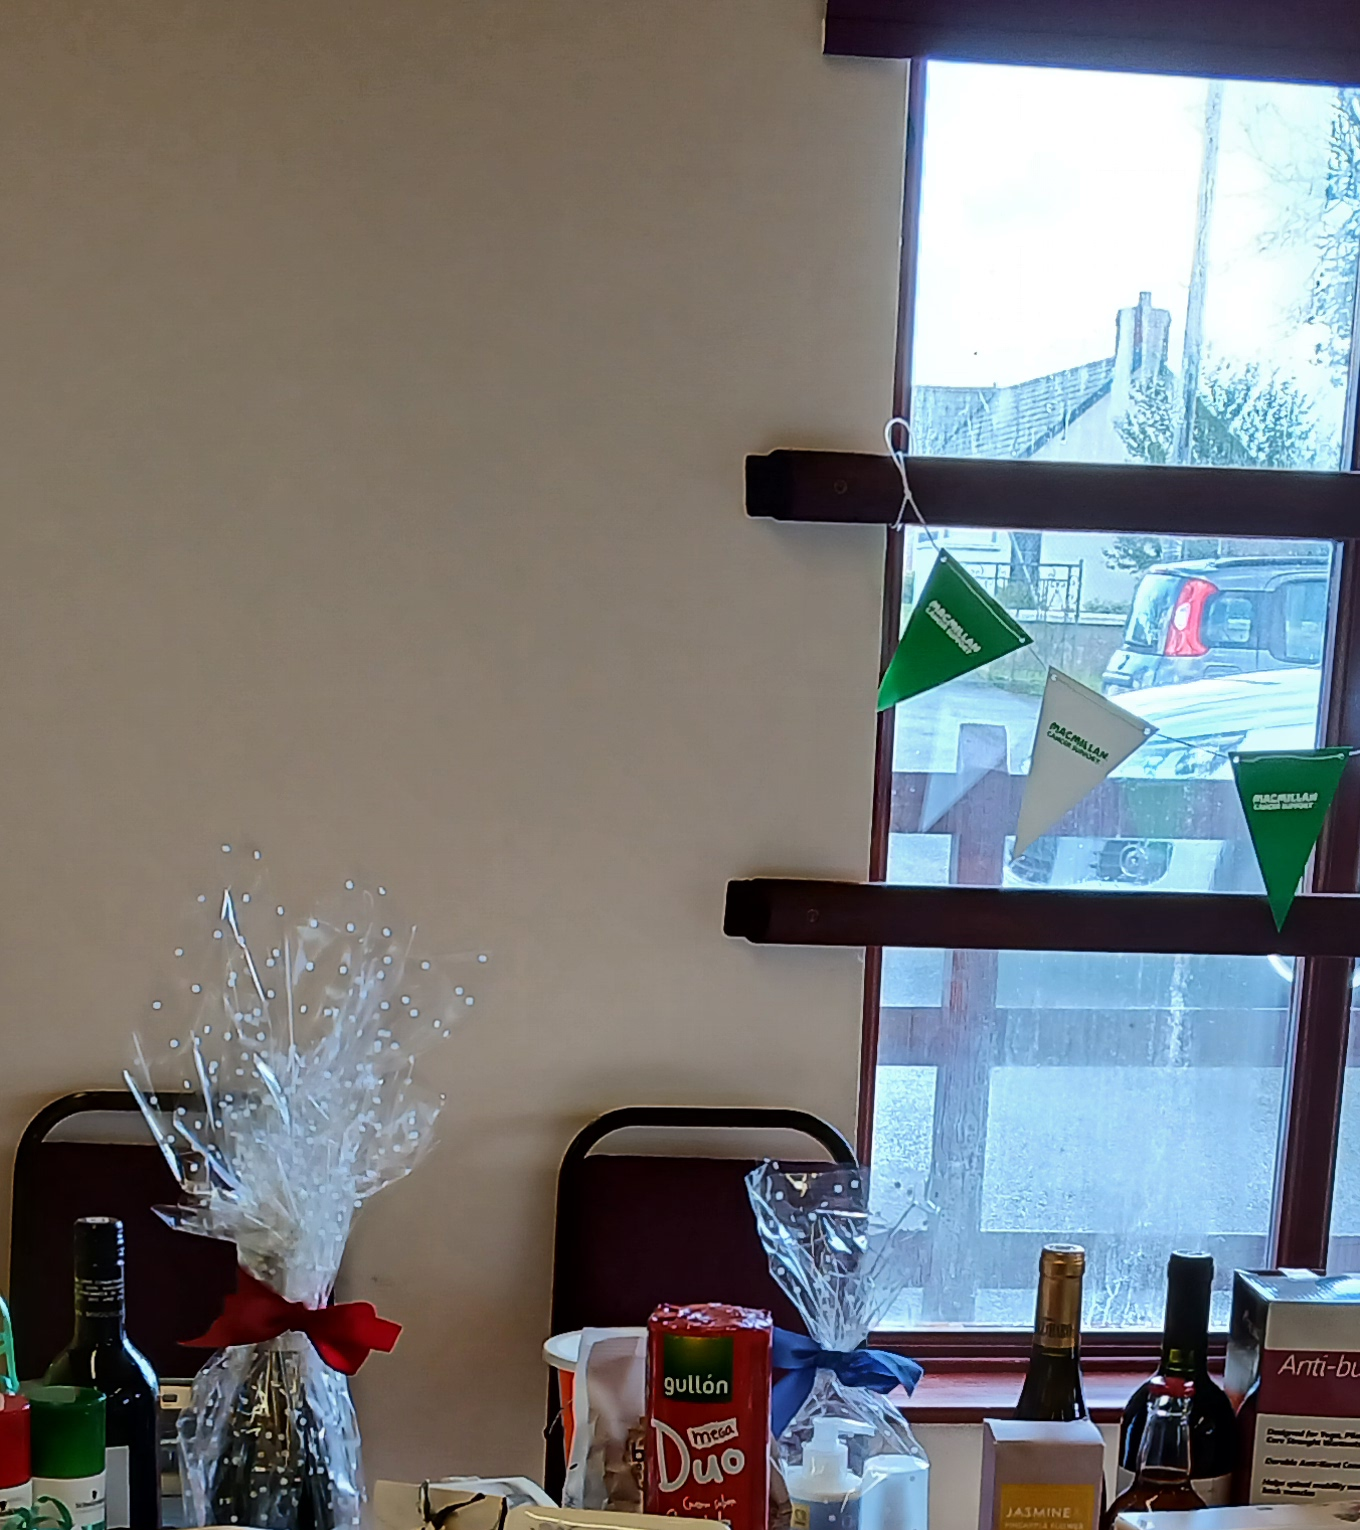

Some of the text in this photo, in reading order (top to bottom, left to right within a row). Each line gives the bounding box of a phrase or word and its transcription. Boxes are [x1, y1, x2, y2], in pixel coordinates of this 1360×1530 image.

[929, 600, 981, 653] MACMILLAN
[1049, 722, 1109, 760] MACMILLAN
[1253, 792, 1318, 804] MACMILLAN
[664, 1373, 728, 1396] gullón
[651, 1418, 745, 1493] Duo
[1006, 1507, 1071, 1519] JASMINE
